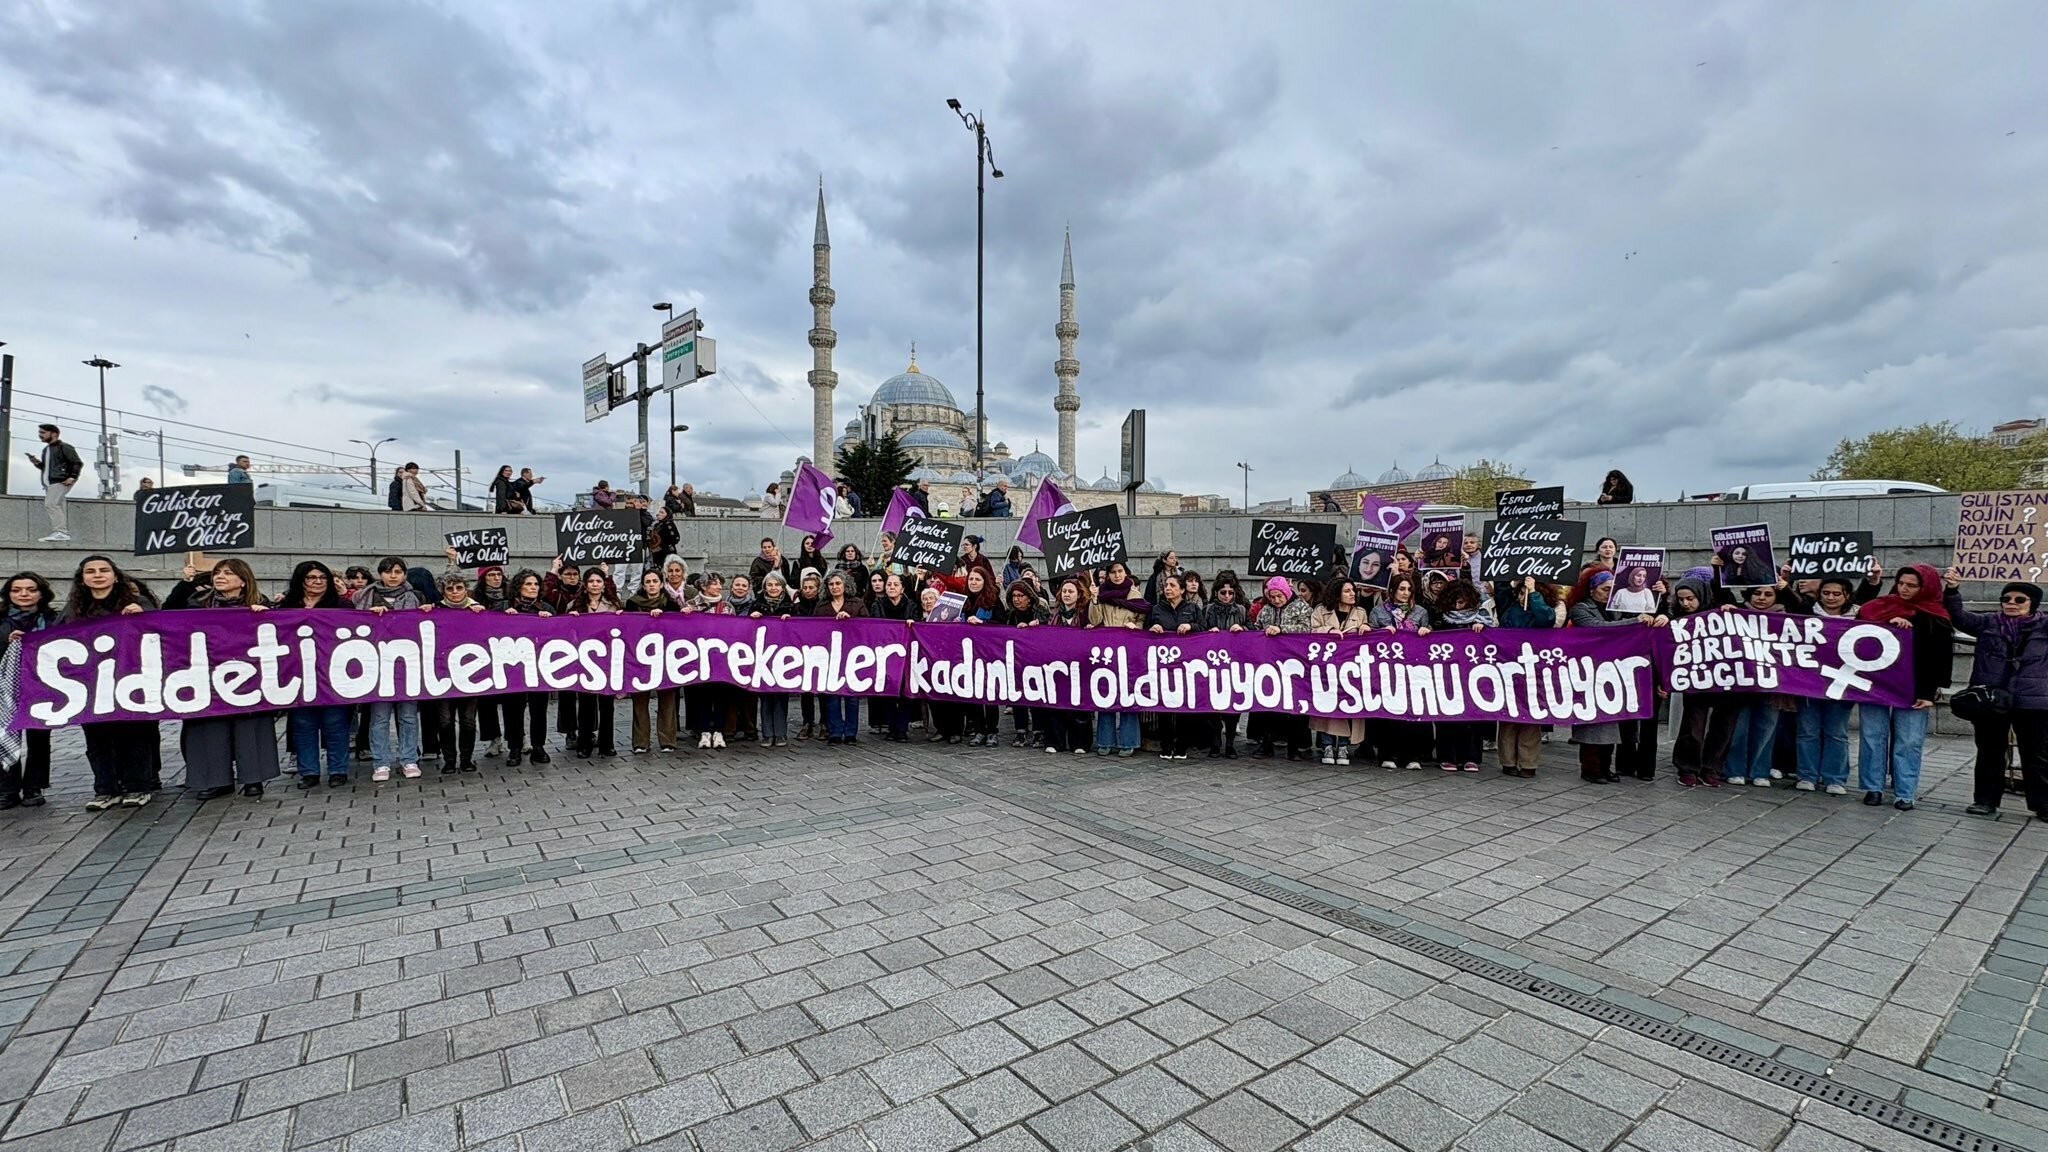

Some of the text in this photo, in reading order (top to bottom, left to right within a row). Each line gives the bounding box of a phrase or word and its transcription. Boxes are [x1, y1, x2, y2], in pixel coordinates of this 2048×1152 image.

[143, 490, 223, 513] Gülistan
[1499, 492, 1534, 505] Esma
[1961, 492, 2048, 507] GÜLİSTAN
[171, 510, 242, 532] Doku'ya
[561, 513, 615, 532] Nadira
[1960, 507, 2014, 522] ROJİN
[146, 523, 250, 551] Ne Oldu?
[481, 531, 506, 545] Er'e
[575, 529, 642, 546] Kadirova'ya
[1491, 522, 1562, 545] Yeldana
[1714, 529, 1765, 541] GÜLİSTAN DOKU
[1958, 522, 2037, 536] ROJVELAT
[1069, 528, 1121, 551] Zorlu'ya
[1791, 536, 1858, 556] Narin'e
[1957, 537, 2018, 550] İLAYDA
[456, 547, 508, 565] Ne Oldu?
[563, 545, 635, 561] Ne Oldu?
[895, 546, 945, 567] Ne Oldu?
[1055, 543, 1120, 573] Ne Oldu?
[1484, 544, 1575, 559] Kaharman'a
[1956, 552, 2036, 564] YELDANA
[1255, 556, 1324, 575] Ne Oldu?
[1484, 557, 1572, 580] Ne Oldu?
[1791, 555, 1874, 576] Ne Oldu?
[1956, 565, 2022, 579] NADİRA
[1670, 611, 1827, 644] KADINLAR
[1673, 636, 1819, 668] BİRLİKTE
[30, 620, 1651, 725] Şiddeti önlemesi gerekenler kadınları öldürüyor, üstünü örtüyor
[1670, 661, 1778, 691] GÜÇLÜ
